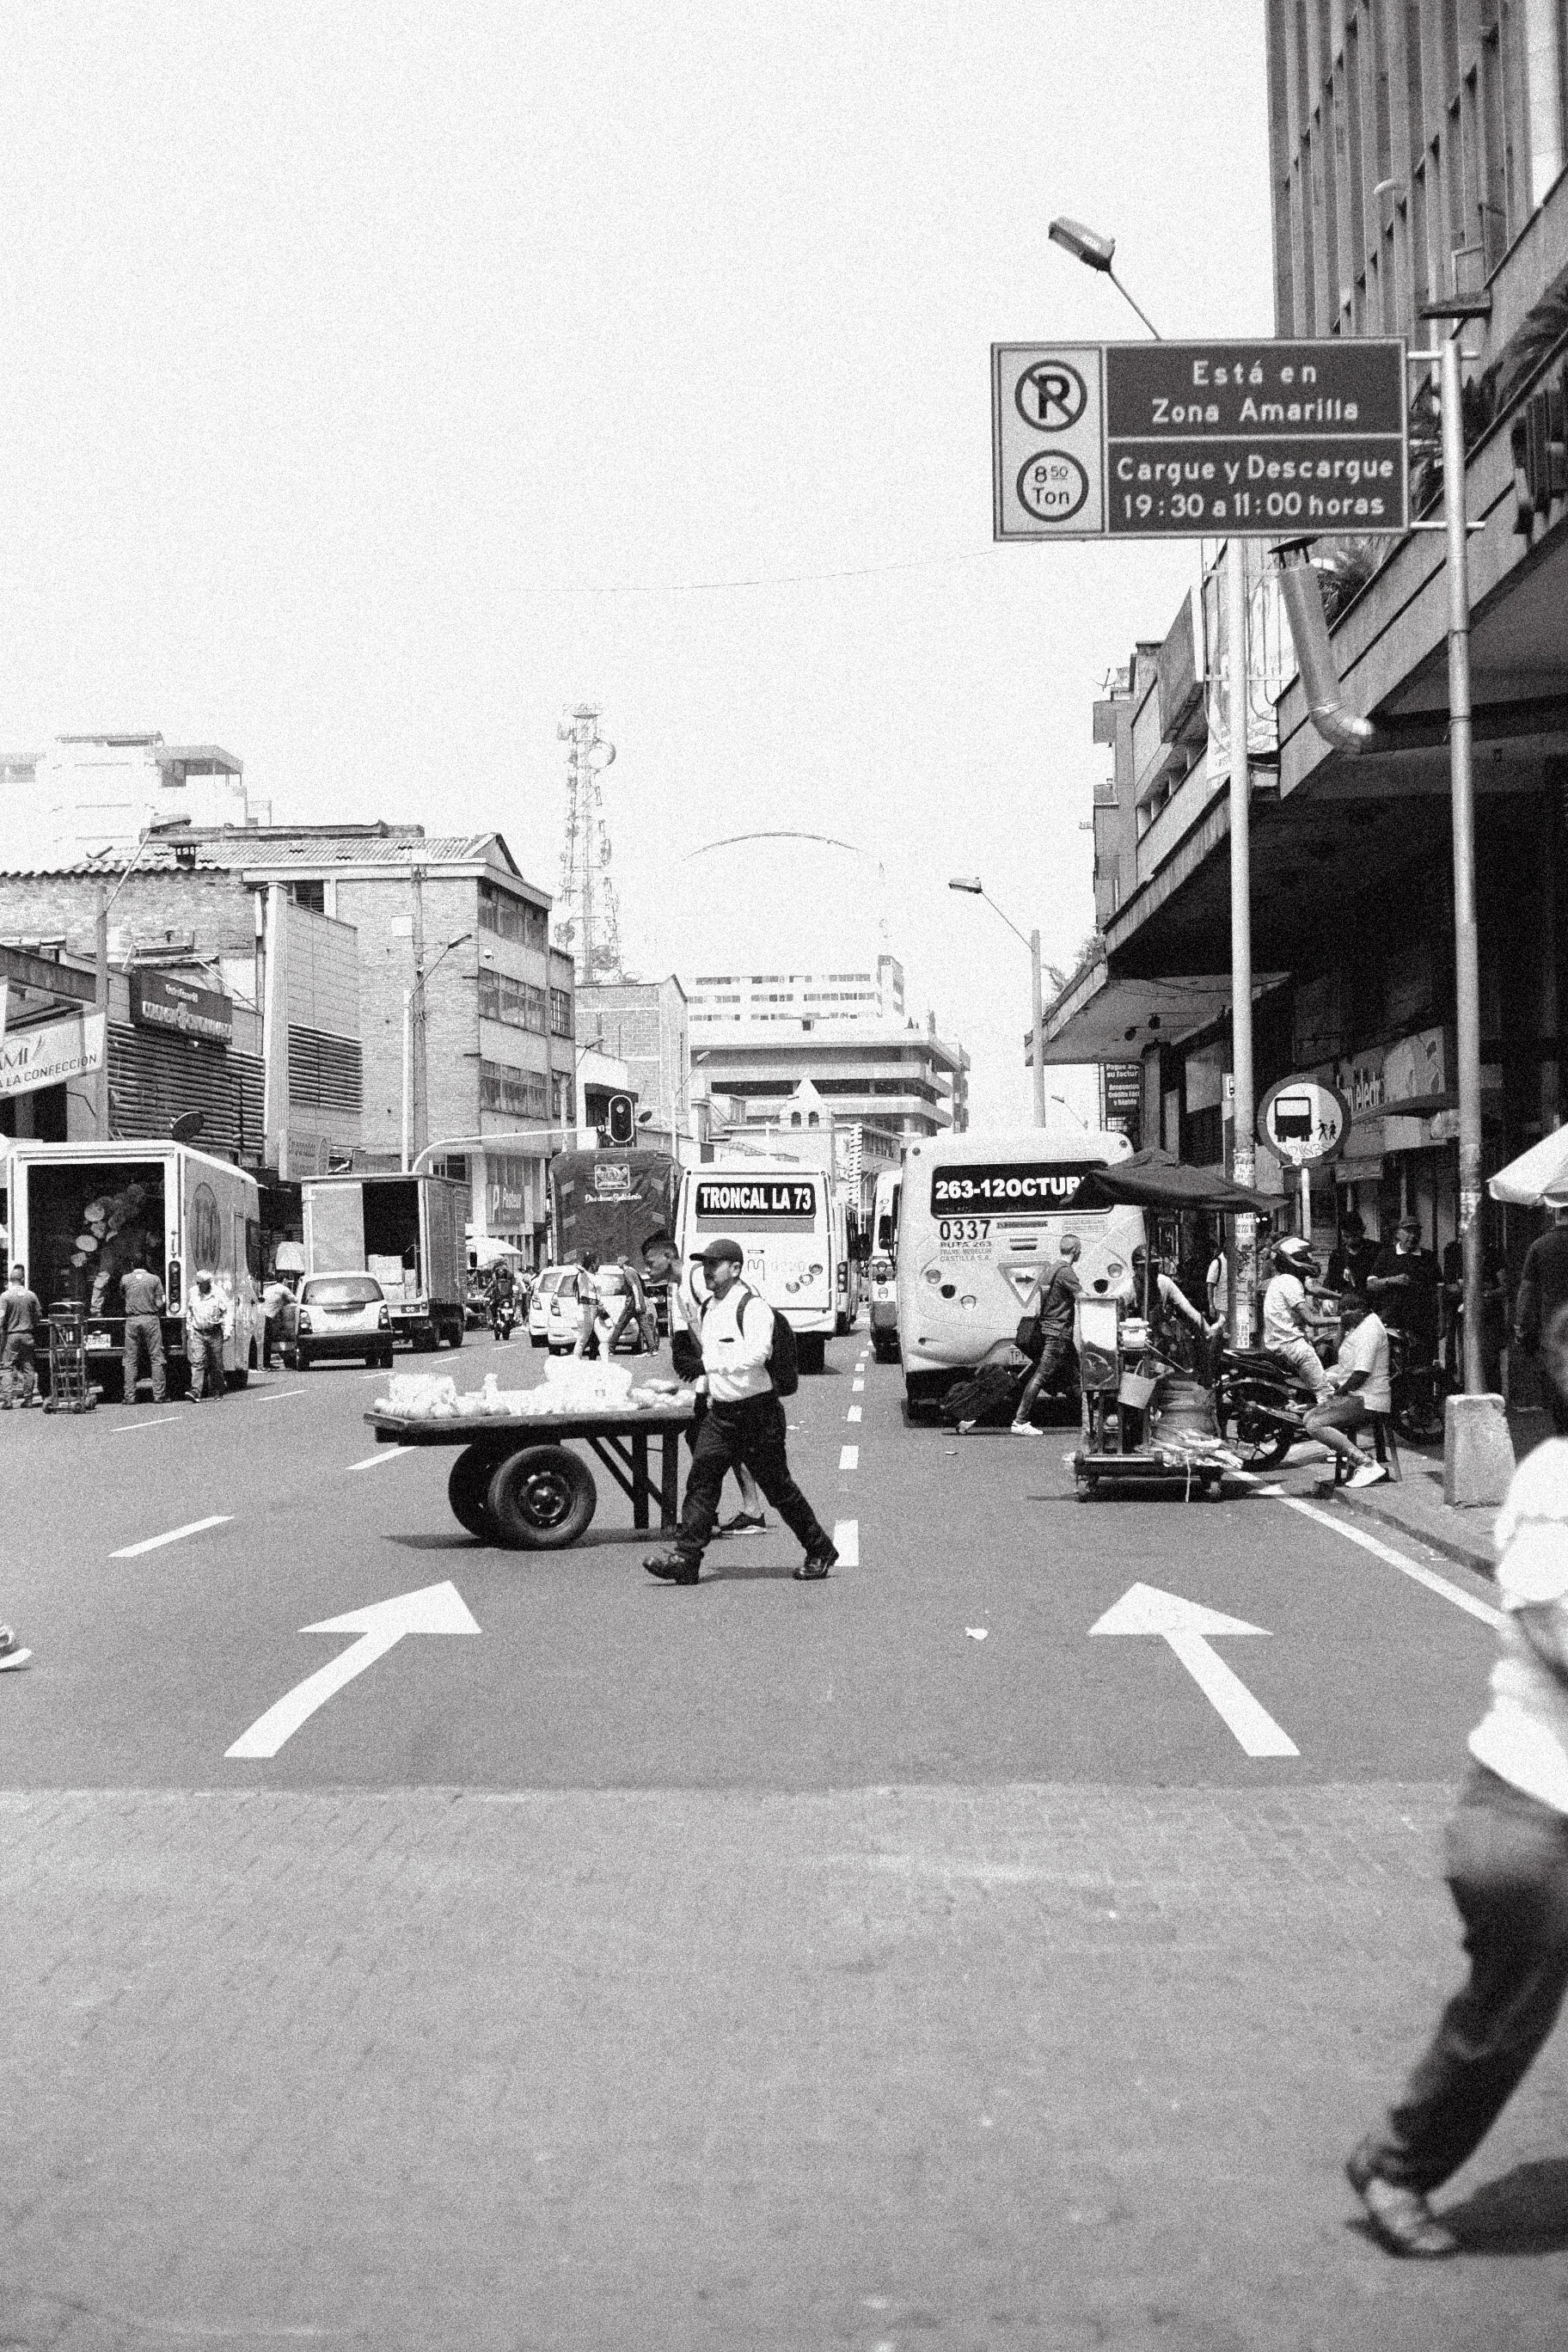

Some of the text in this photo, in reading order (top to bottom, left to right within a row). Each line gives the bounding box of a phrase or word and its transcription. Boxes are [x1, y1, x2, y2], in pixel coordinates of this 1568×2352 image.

[1192, 359, 1317, 385] Está en
[1152, 397, 1359, 424] Zona Amarilla
[1117, 455, 1394, 487] Cargue y Descargue
[1032, 487, 1070, 505] Ton
[1212, 499, 1228, 517] a
[1309, 494, 1385, 516] horas
[0, 1047, 28, 1071] MI
[7, 1075, 21, 1087] LA
[24, 1054, 97, 1082] CONFECCION
[701, 1186, 812, 1210] TRONCAL LA 73
[940, 1219, 992, 1240] 0337
